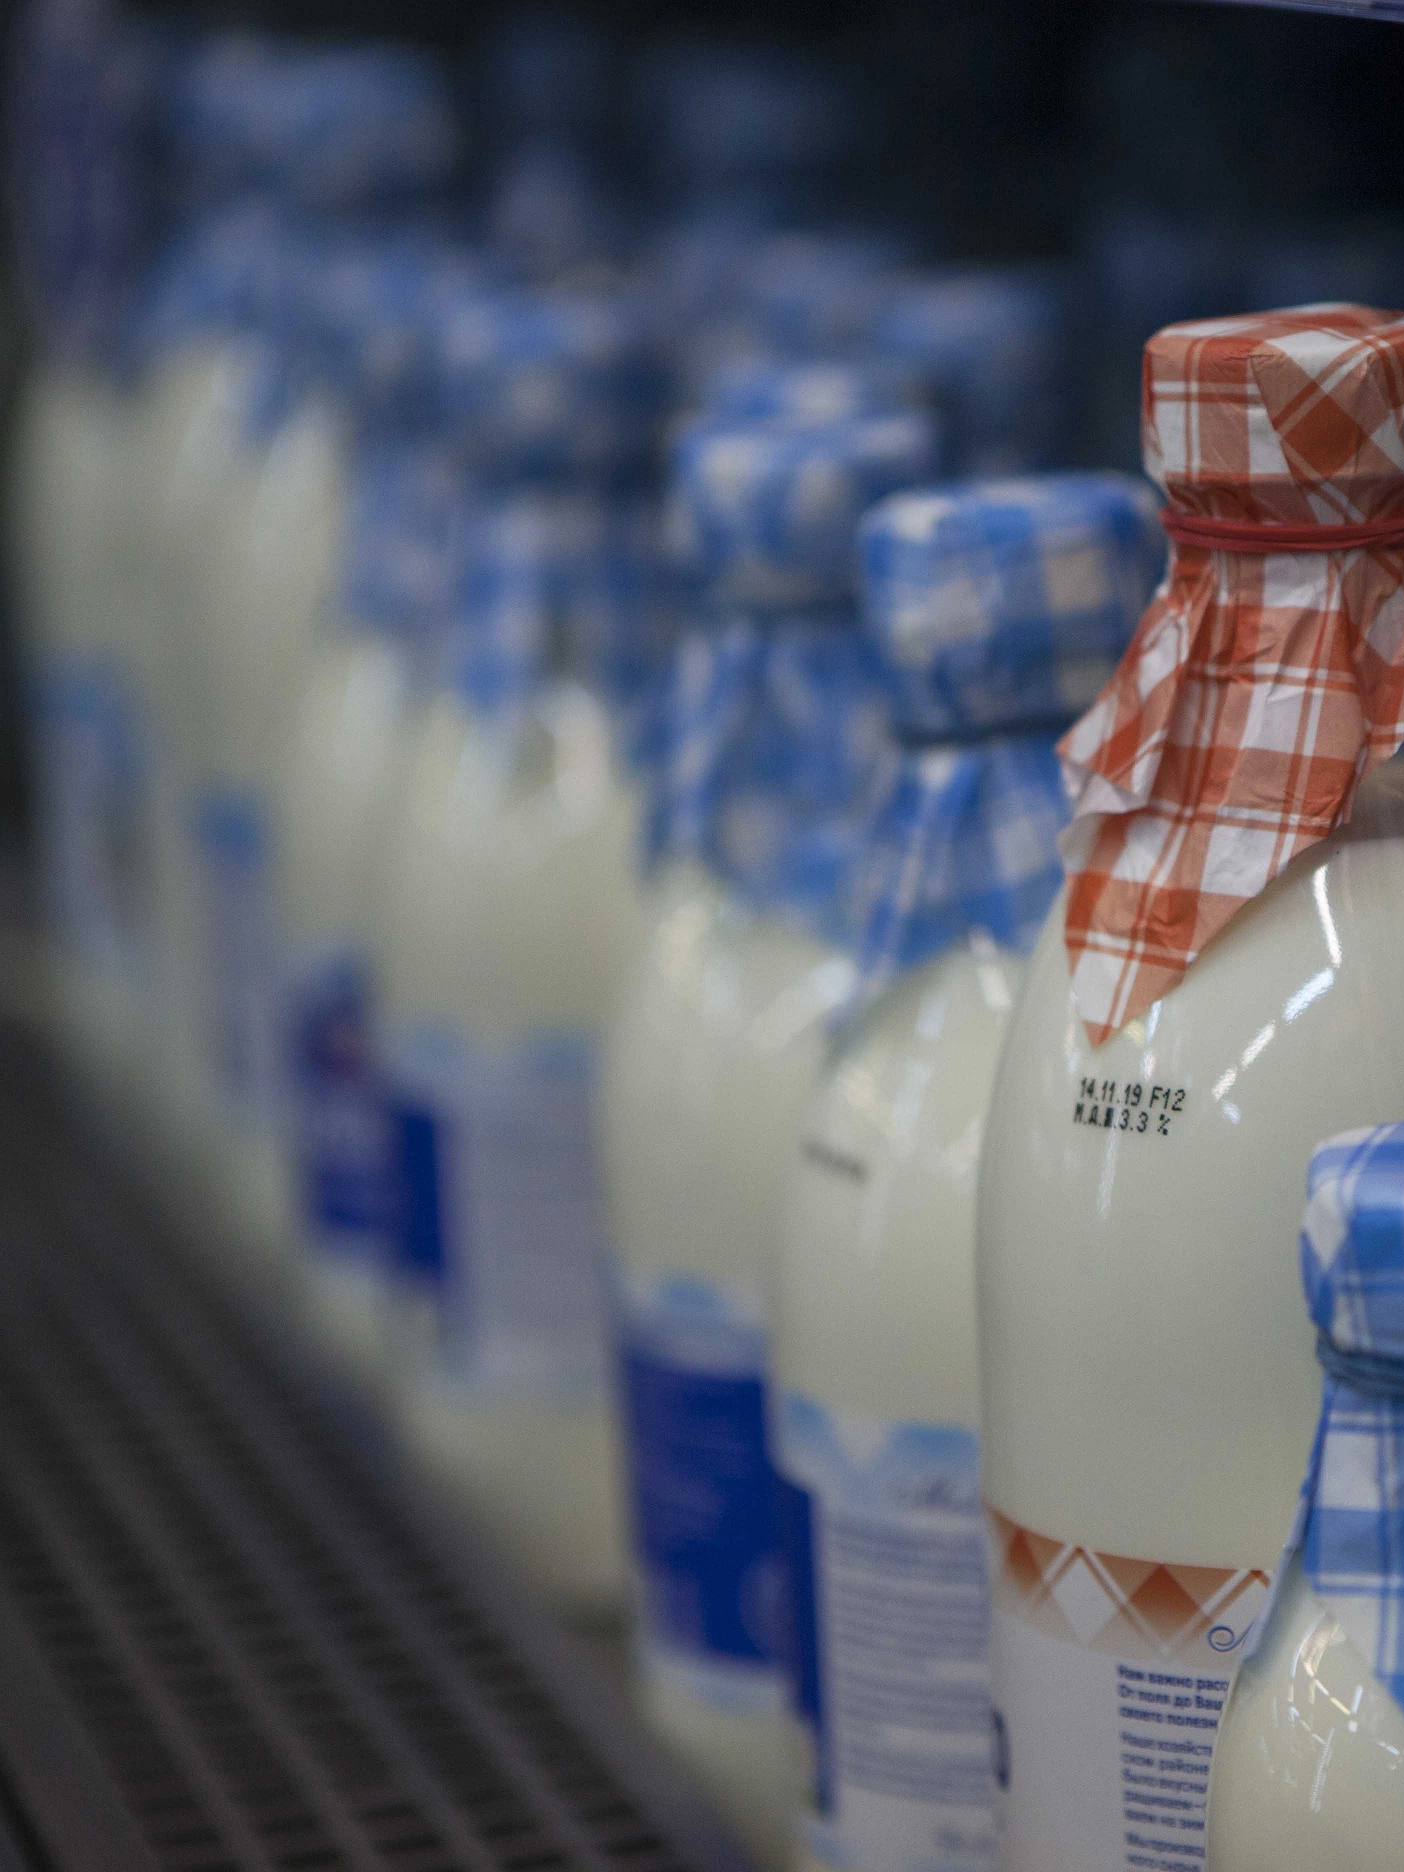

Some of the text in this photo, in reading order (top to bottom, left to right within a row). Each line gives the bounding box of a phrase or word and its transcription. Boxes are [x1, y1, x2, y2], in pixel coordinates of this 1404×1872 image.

[1080, 1077, 1186, 1111] 14.11.19 F12
[1148, 1672, 1194, 1689] важно
[1118, 1683, 1135, 1698] От
[1138, 1690, 1169, 1705] поля
[1174, 1695, 1193, 1709] до
